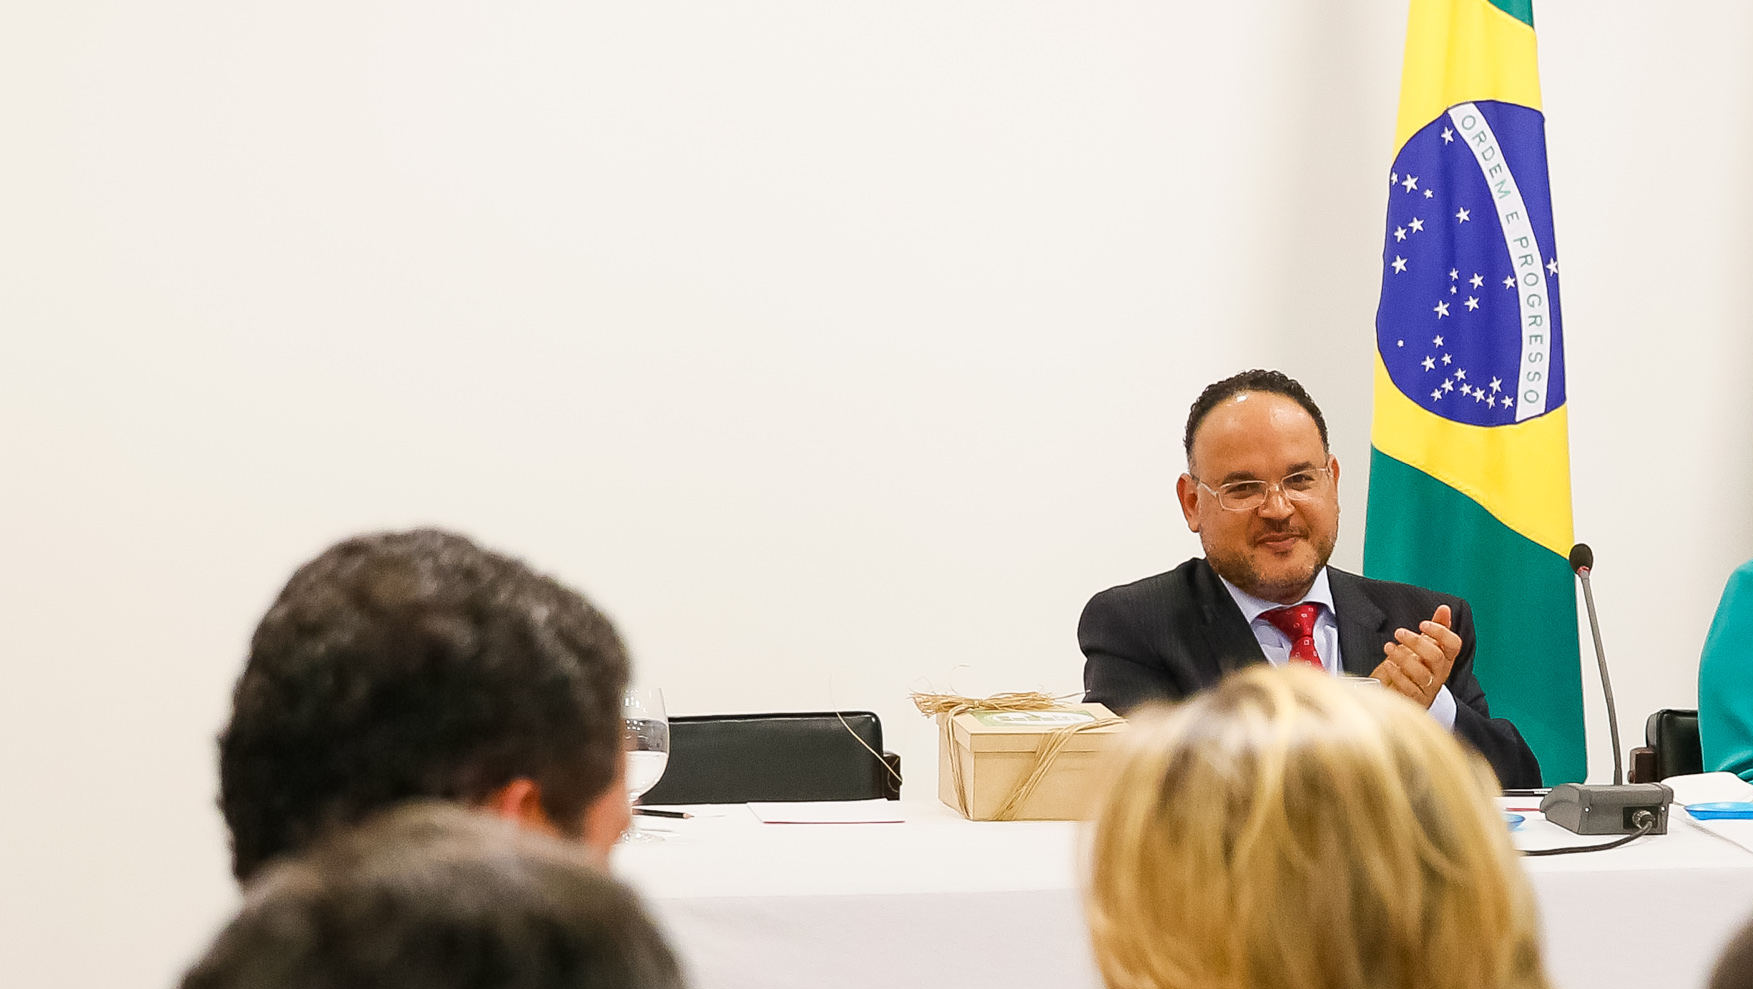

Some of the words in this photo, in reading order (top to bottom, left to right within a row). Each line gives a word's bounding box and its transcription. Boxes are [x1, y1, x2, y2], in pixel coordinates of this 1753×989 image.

[1461, 114, 1512, 200] ORDEM
[1505, 211, 1520, 225] E
[1513, 236, 1544, 404] PROGRESSO
